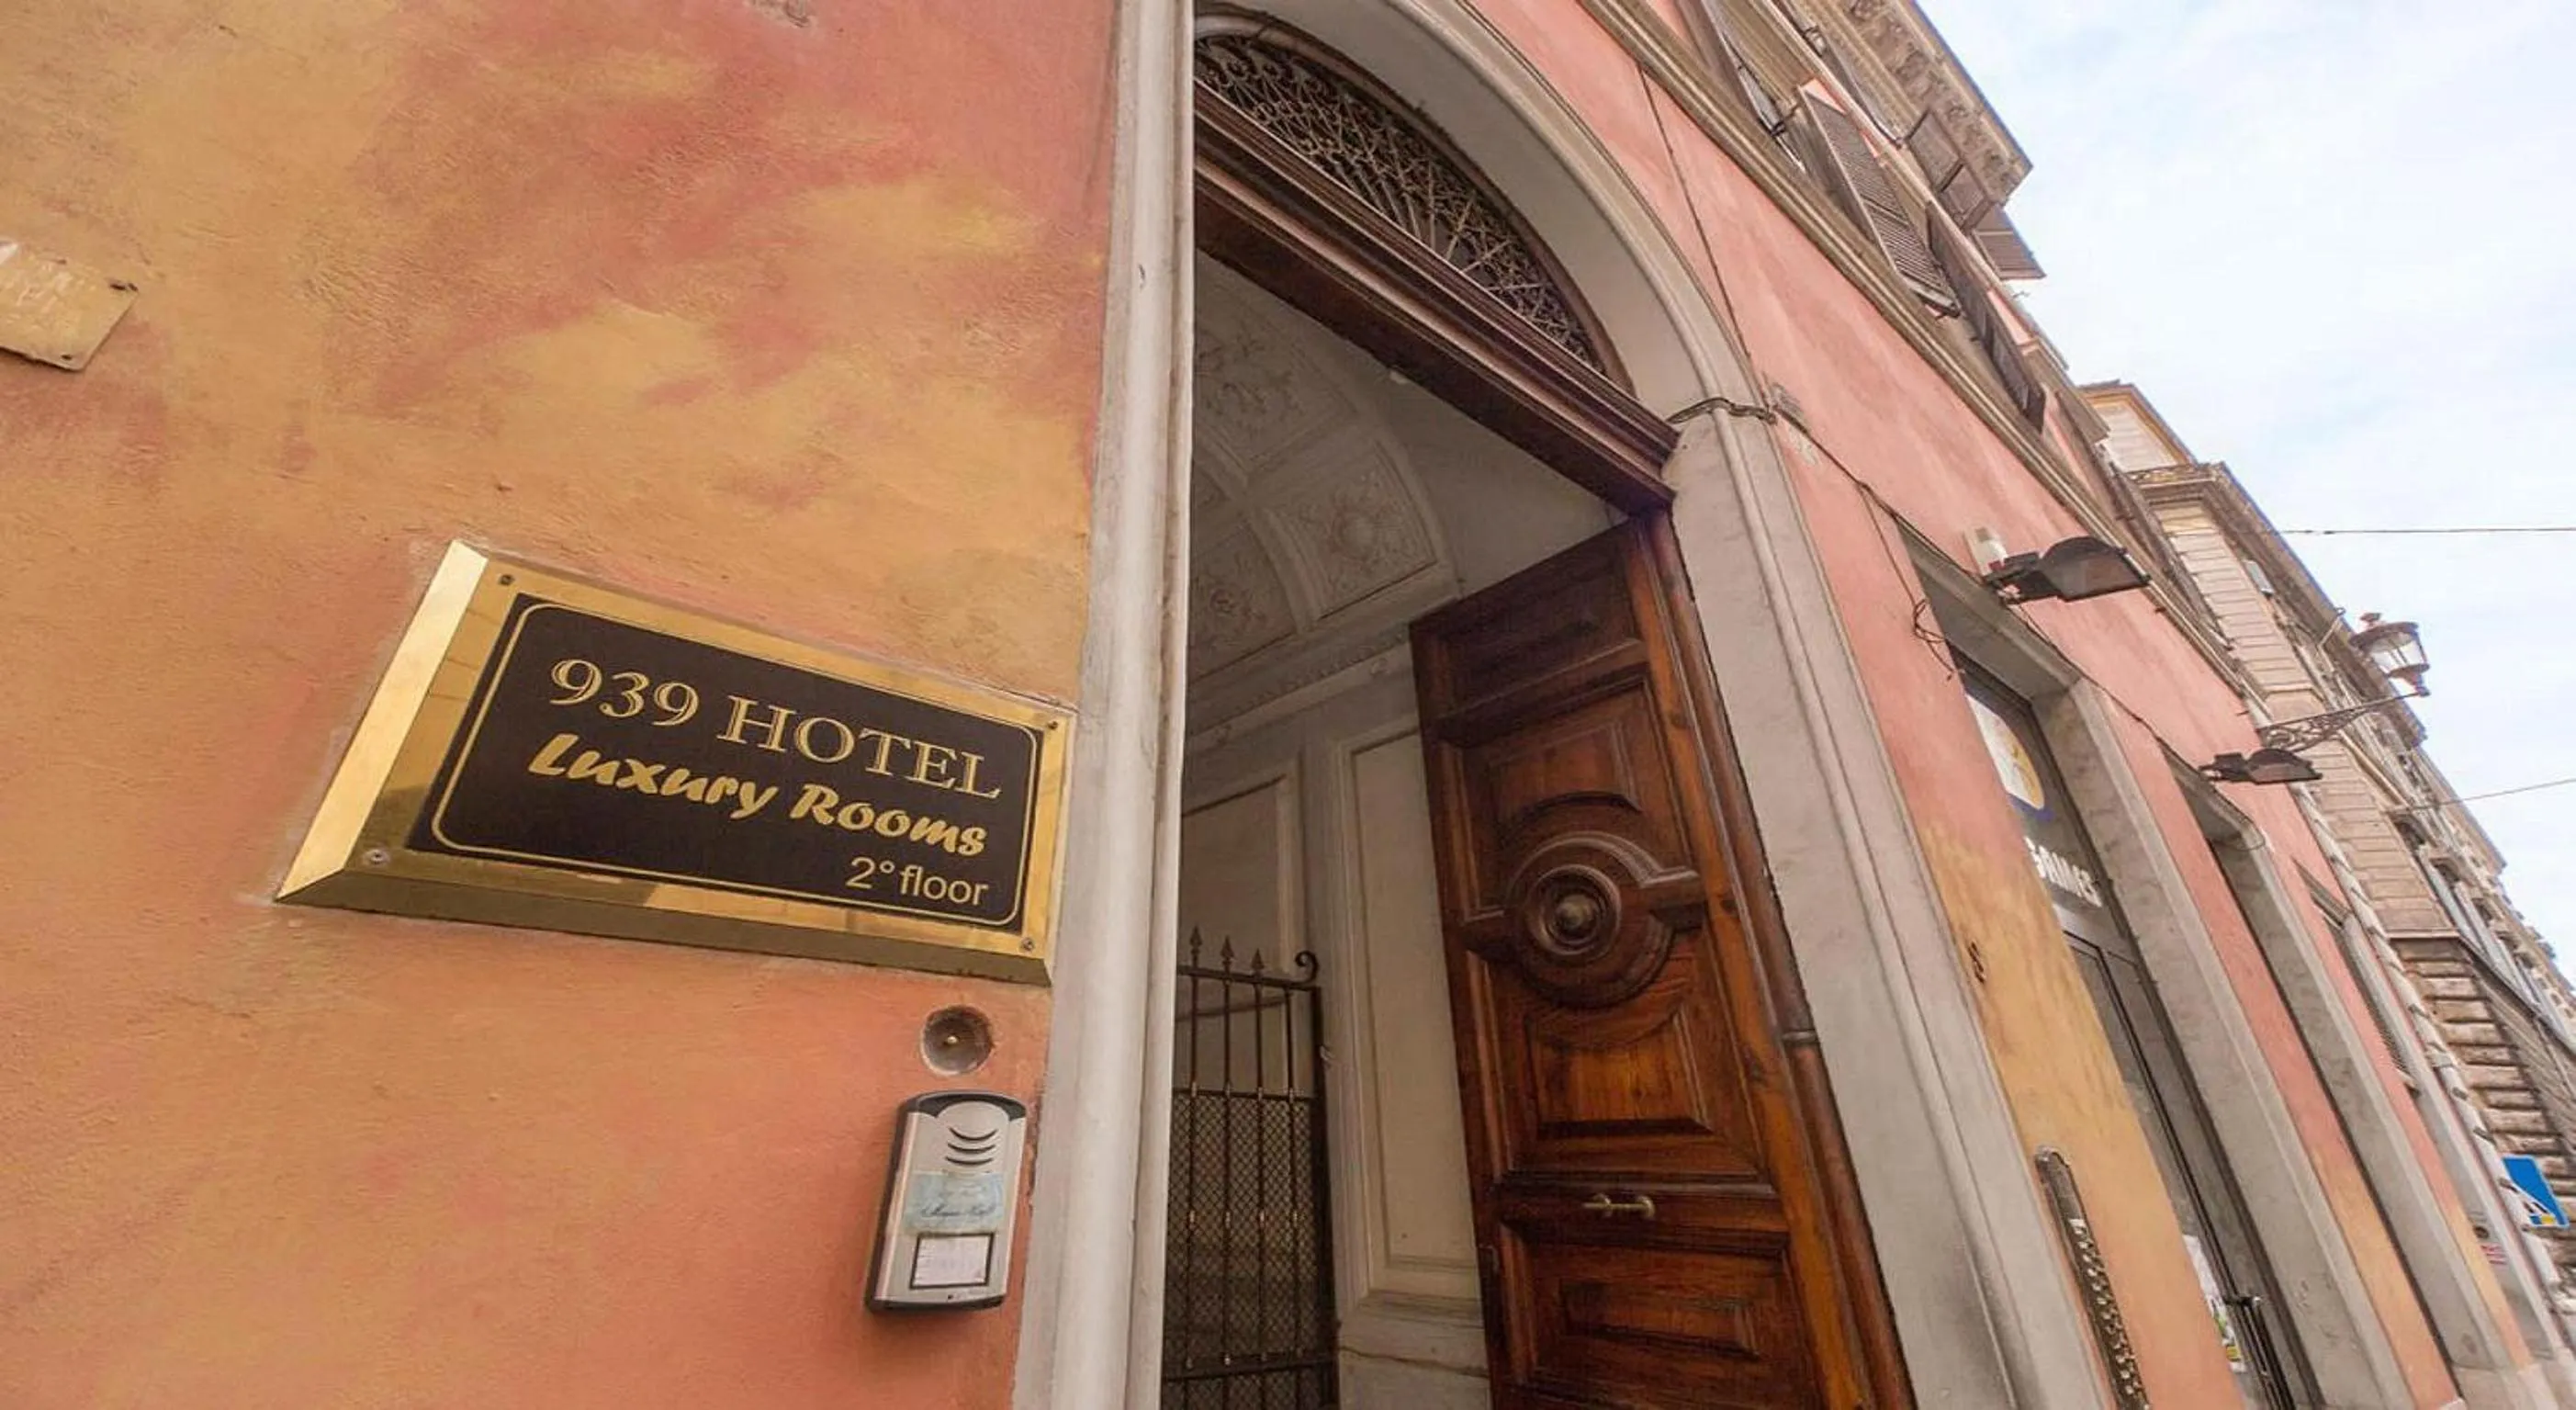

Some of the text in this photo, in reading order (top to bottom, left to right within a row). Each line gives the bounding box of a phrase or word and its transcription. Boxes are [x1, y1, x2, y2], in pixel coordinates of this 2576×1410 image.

[550, 659, 1002, 799] 939 HOTEL
[527, 733, 988, 856] Luxury Rooms
[844, 856, 989, 906] 2° floor
